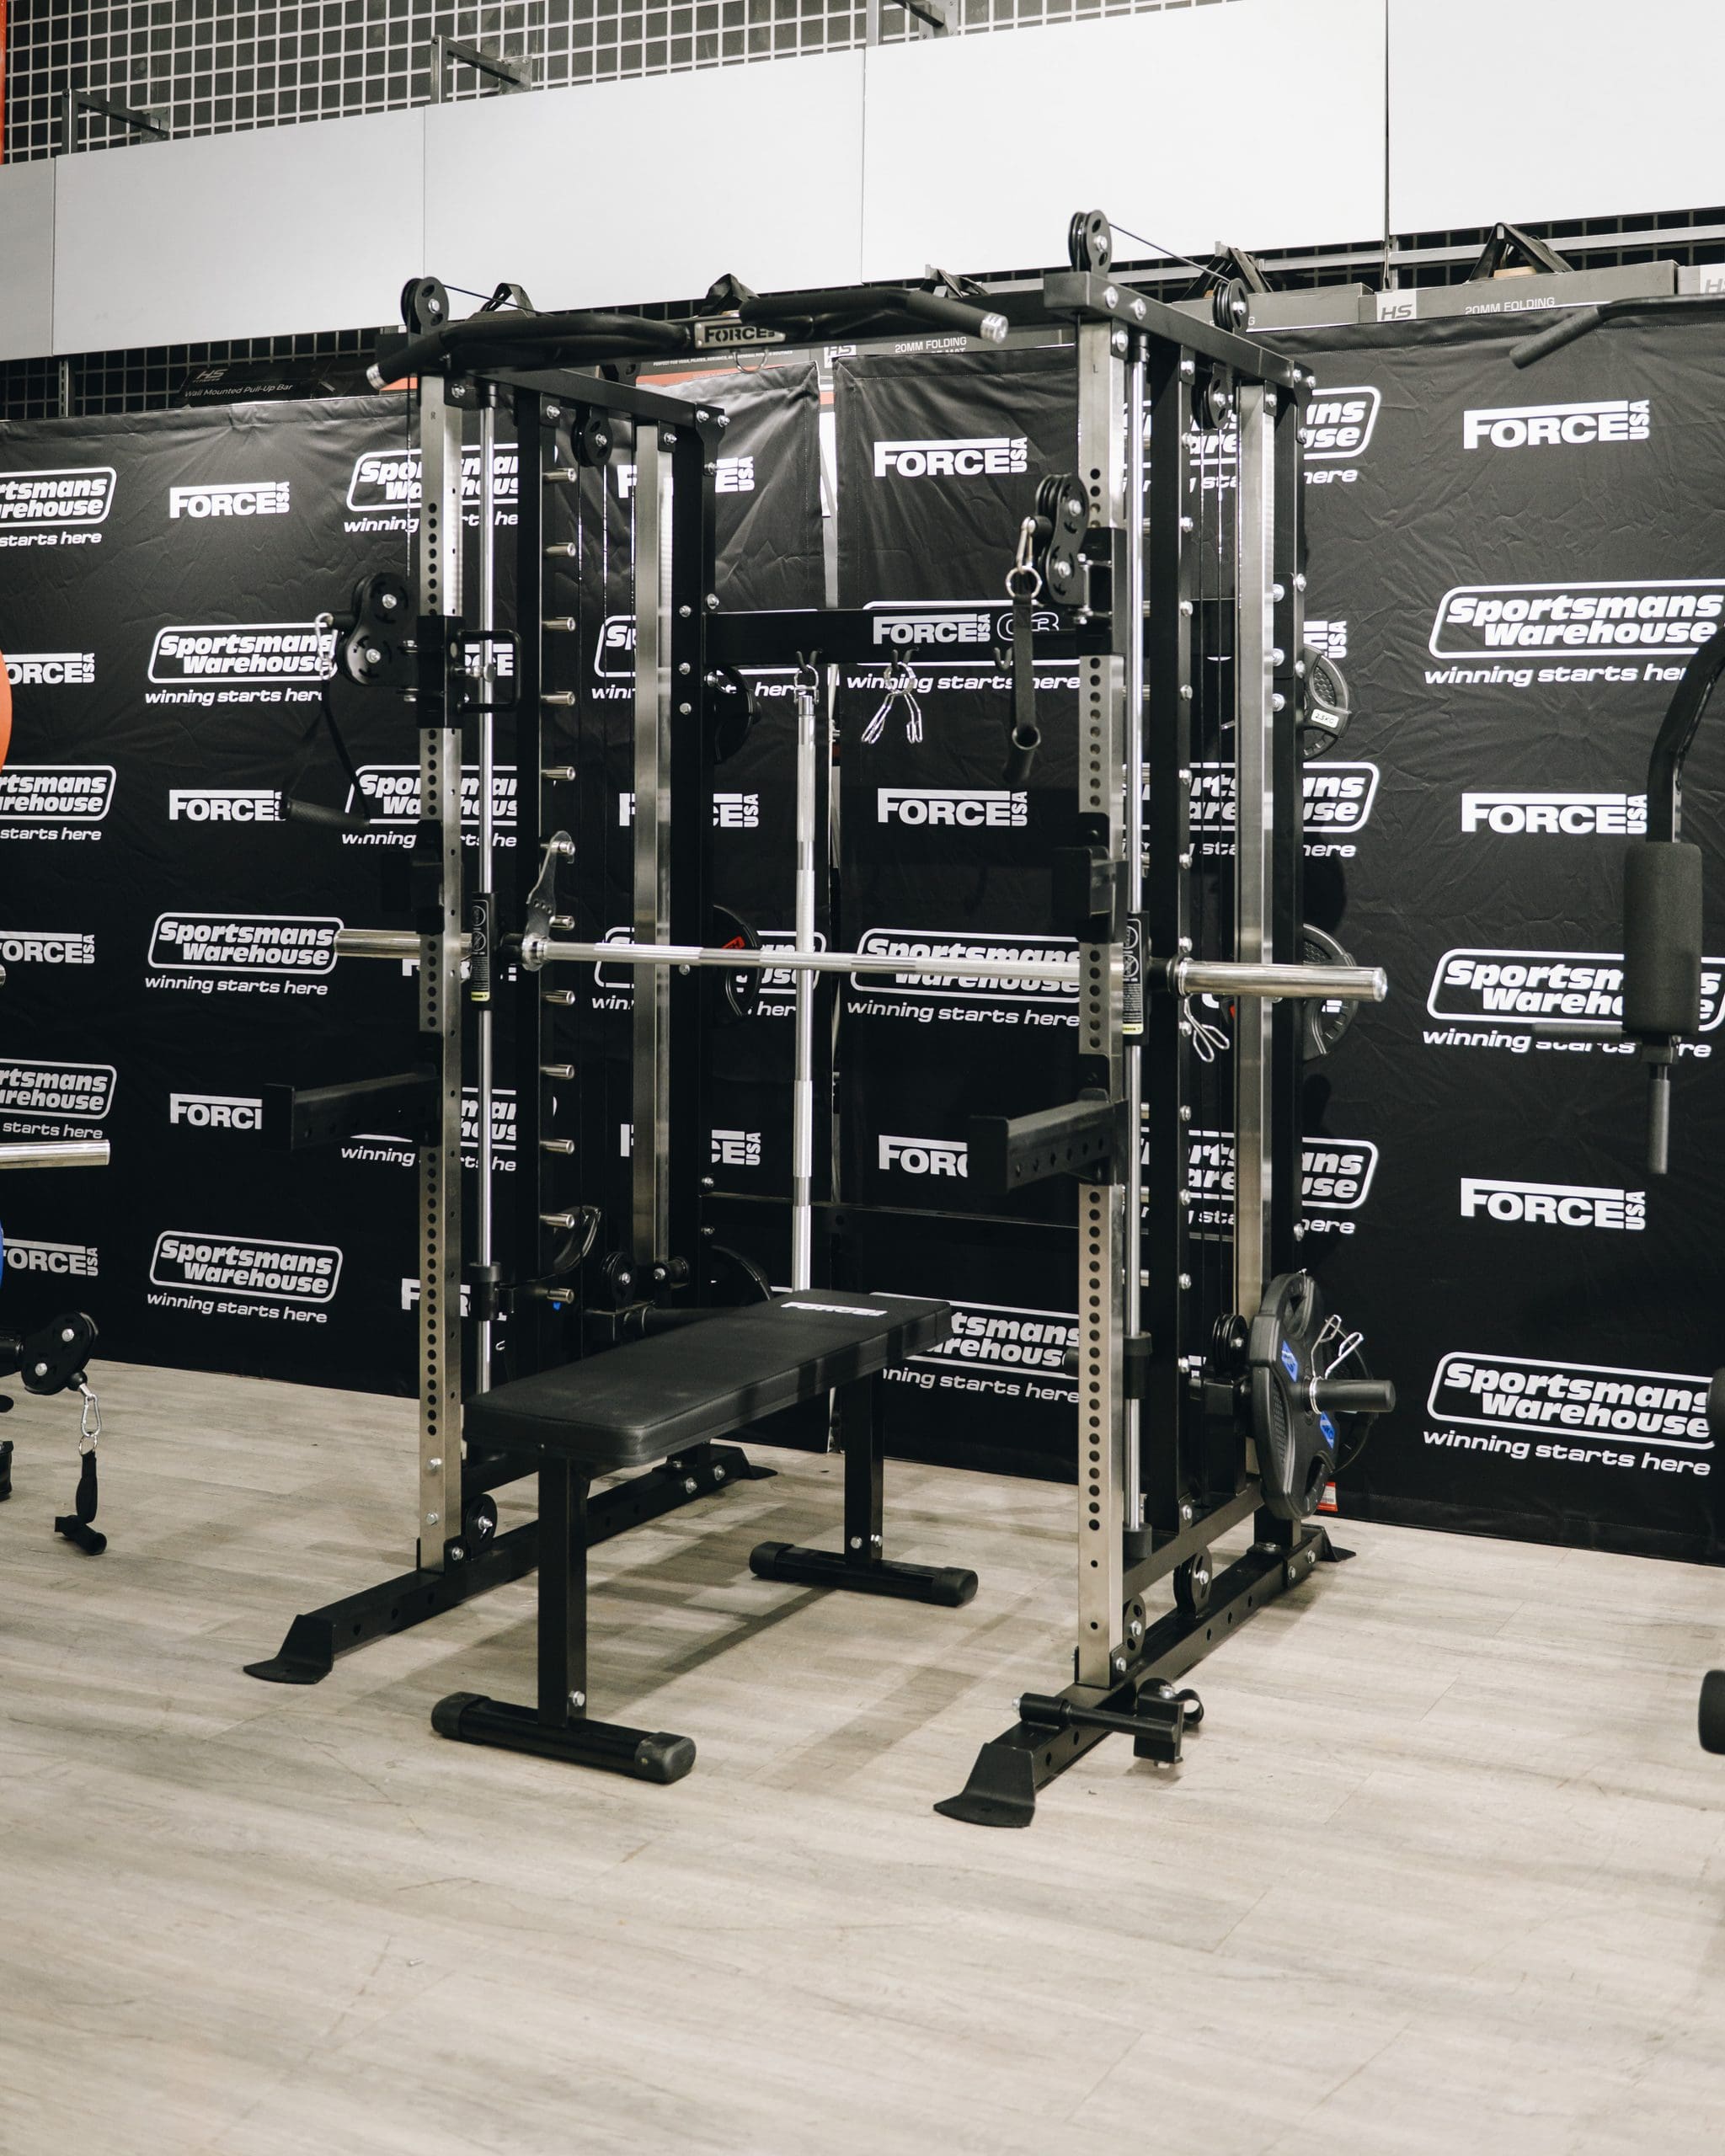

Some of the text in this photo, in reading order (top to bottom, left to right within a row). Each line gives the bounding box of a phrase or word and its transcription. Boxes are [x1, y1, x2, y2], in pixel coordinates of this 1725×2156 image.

[1381, 304, 1413, 320] HS
[1466, 296, 1556, 315] 20MM FOLDING
[705, 325, 766, 344] FORCE
[895, 341, 923, 354] 20MM
[926, 337, 966, 350] FOLDING
[195, 368, 228, 379] HS
[184, 389, 203, 398] Wall
[204, 387, 242, 397] Mounted
[243, 384, 275, 394] Pull-Up
[1463, 399, 1650, 450] FORCE USA
[873, 436, 1028, 478] FORCE USA
[738, 456, 756, 492] USA
[169, 480, 290, 519] FORCE USA
[60, 531, 102, 546] here
[344, 515, 419, 534] winning
[1446, 593, 1724, 627] Sportsmans
[873, 613, 977, 645] FORCE
[977, 613, 991, 643] USA
[1328, 620, 1348, 659] USA
[1484, 620, 1718, 647] Warehouse
[3, 653, 95, 685] ORCE USA
[1424, 665, 1535, 688] winning
[1537, 665, 1638, 682] starts
[145, 690, 213, 707] winning
[217, 689, 281, 703] starts
[169, 789, 275, 821] FORCE
[743, 793, 759, 828] USA
[878, 787, 1028, 827] FORCE USA
[1461, 792, 1648, 835] FORCE USA
[0, 826, 102, 841] starts here
[83, 934, 95, 964] USA
[158, 921, 334, 947] Sportsmans
[182, 942, 330, 966] Warehouse
[144, 974, 328, 995] winning starts here
[846, 1000, 1080, 1027] winning starts here
[1422, 1027, 1532, 1054] winning
[3, 1121, 103, 1139] starts here
[341, 1145, 416, 1167] winning
[745, 1132, 761, 1166] USA
[1461, 1177, 1645, 1230] FORCE USA
[3, 1238, 99, 1276] ORCE USA
[160, 1239, 333, 1275] Sportsmans
[184, 1262, 329, 1294] Warehouse
[147, 1292, 327, 1324] winning starts here
[939, 1374, 1021, 1397] starts
[1025, 1382, 1079, 1403] here
[1482, 1392, 1711, 1438] Warehouse
[1423, 1429, 1712, 1476] winning starts here
